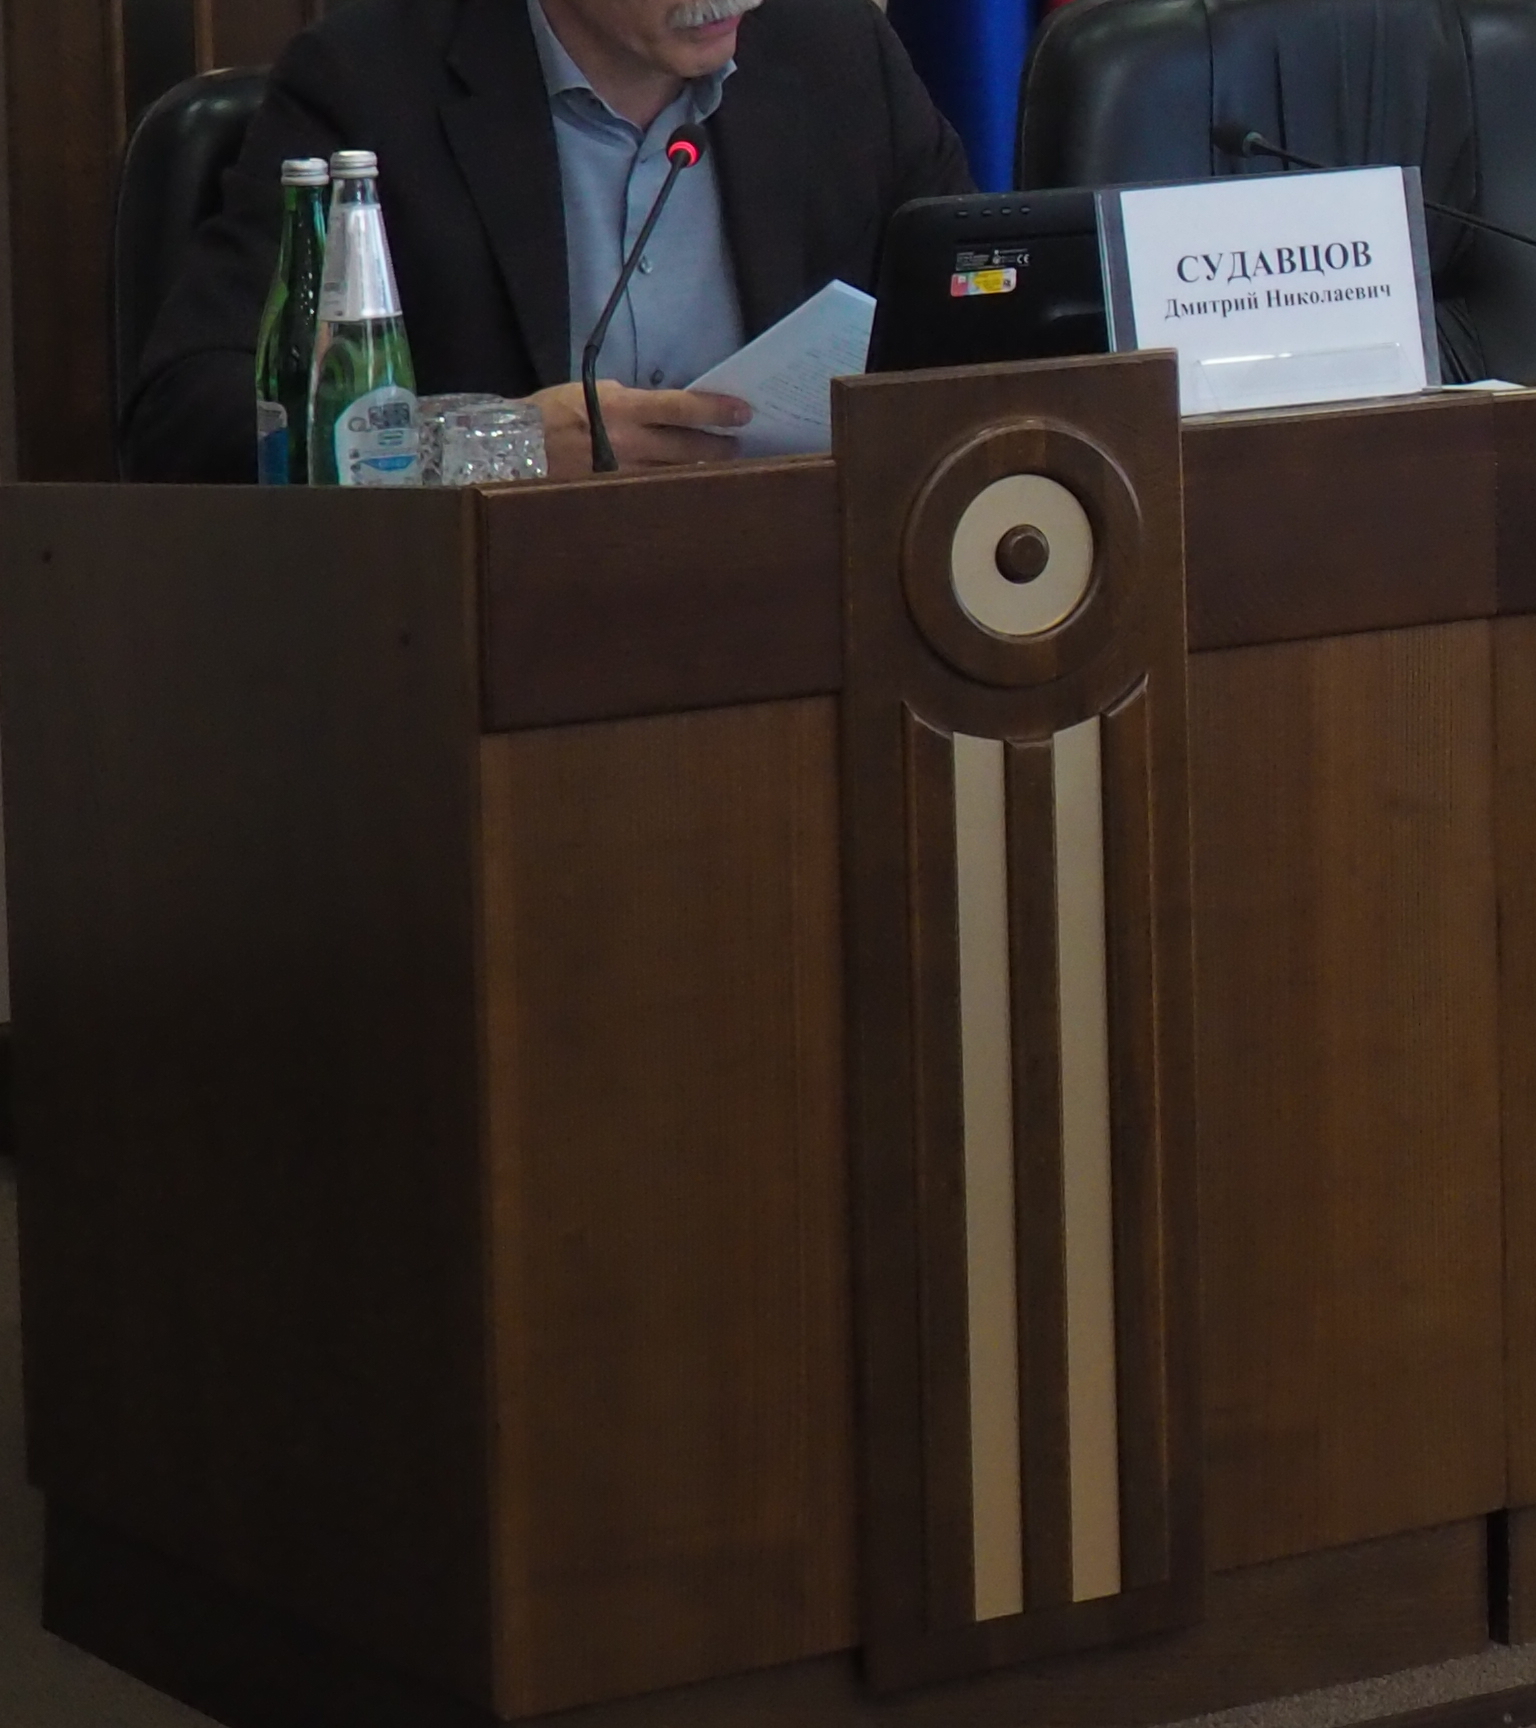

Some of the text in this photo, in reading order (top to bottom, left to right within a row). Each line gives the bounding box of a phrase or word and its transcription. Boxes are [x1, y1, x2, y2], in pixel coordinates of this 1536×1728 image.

[1176, 241, 1373, 283] СУДАВЦОВ
[1165, 283, 1392, 318] Дмитрий Николаевич
